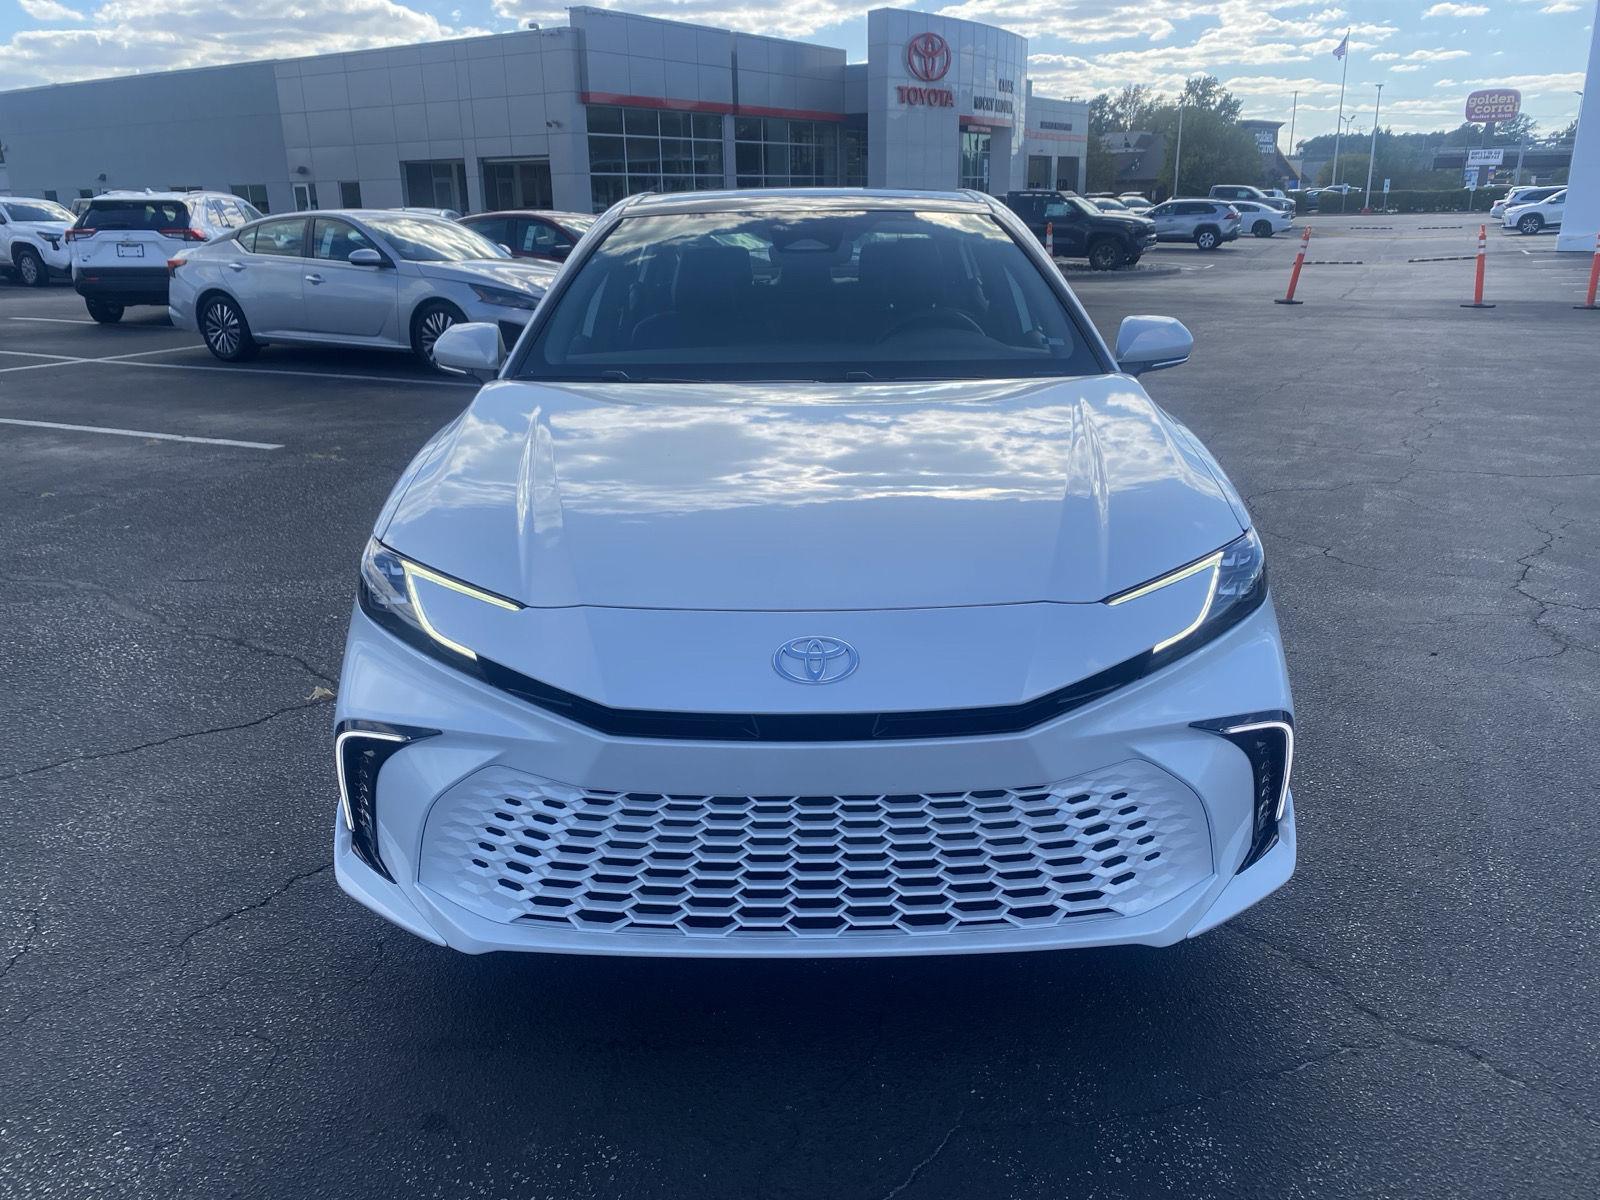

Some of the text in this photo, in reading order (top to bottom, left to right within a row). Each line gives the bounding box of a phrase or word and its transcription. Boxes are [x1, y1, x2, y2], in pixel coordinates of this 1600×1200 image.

[897, 86, 953, 107] TOYOTA
[1469, 94, 1515, 108] golden
[1474, 102, 1518, 114] corral
